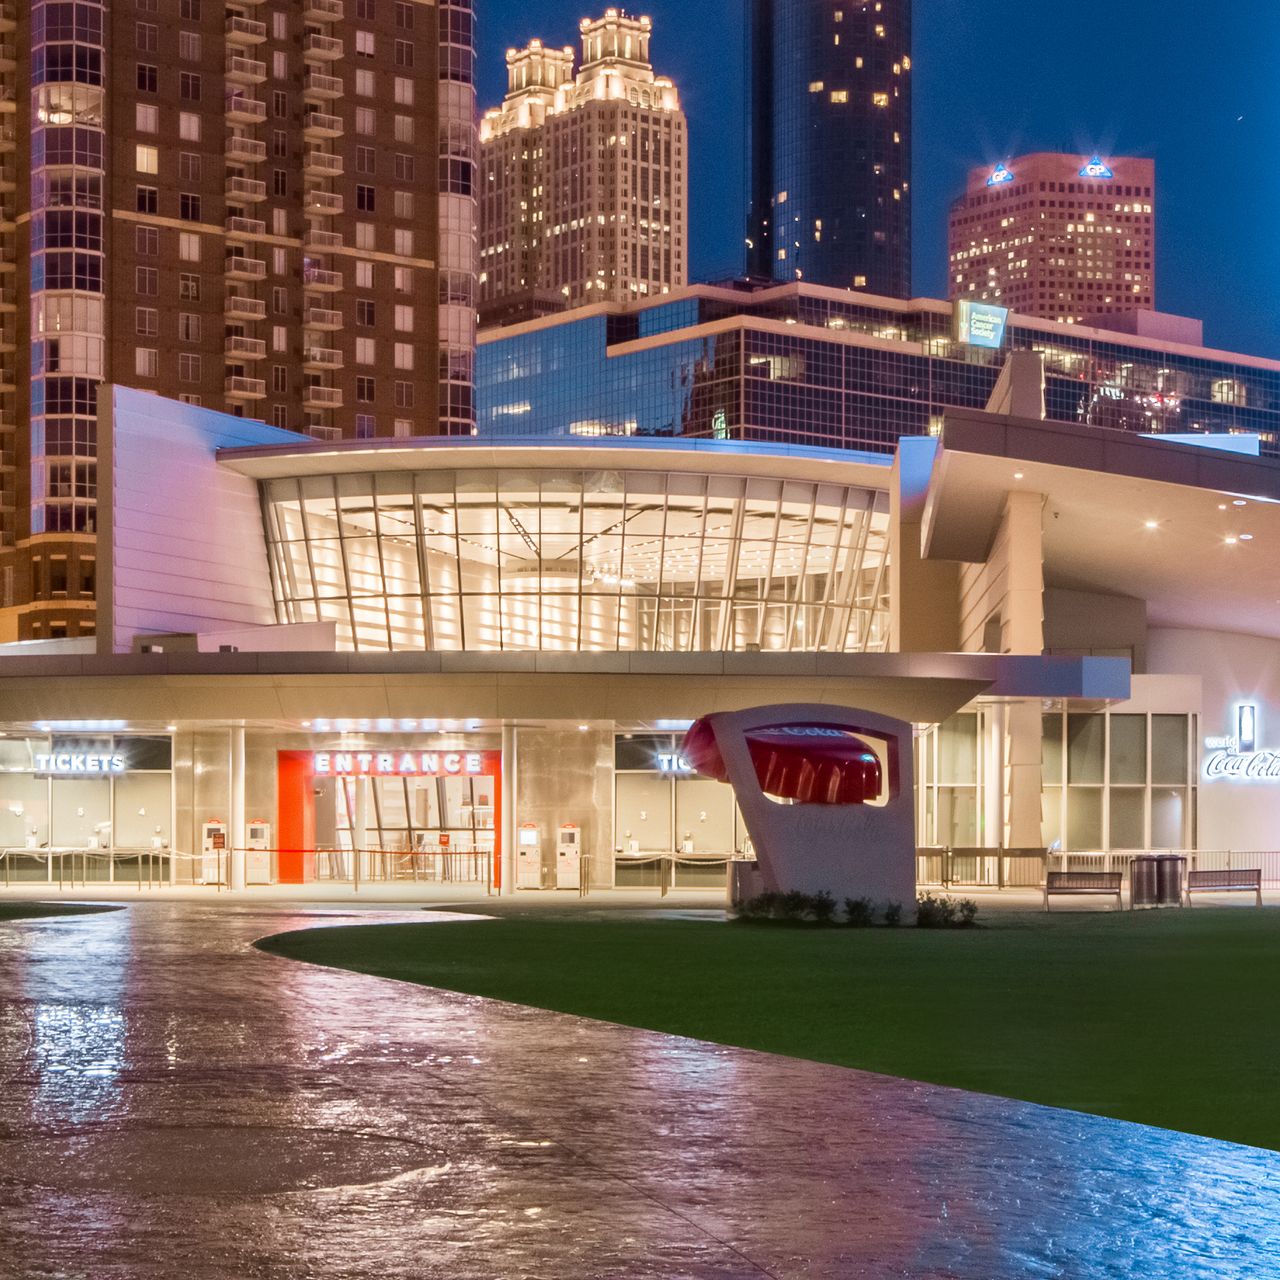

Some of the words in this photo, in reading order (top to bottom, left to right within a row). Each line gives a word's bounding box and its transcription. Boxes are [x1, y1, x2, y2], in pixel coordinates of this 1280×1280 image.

[1086, 164, 1105, 176] GP
[971, 312, 1002, 324] American
[970, 320, 993, 330] Cancer
[970, 327, 995, 339] Society
[36, 754, 125, 772] TICKETS
[314, 752, 482, 773] ENTRANCE
